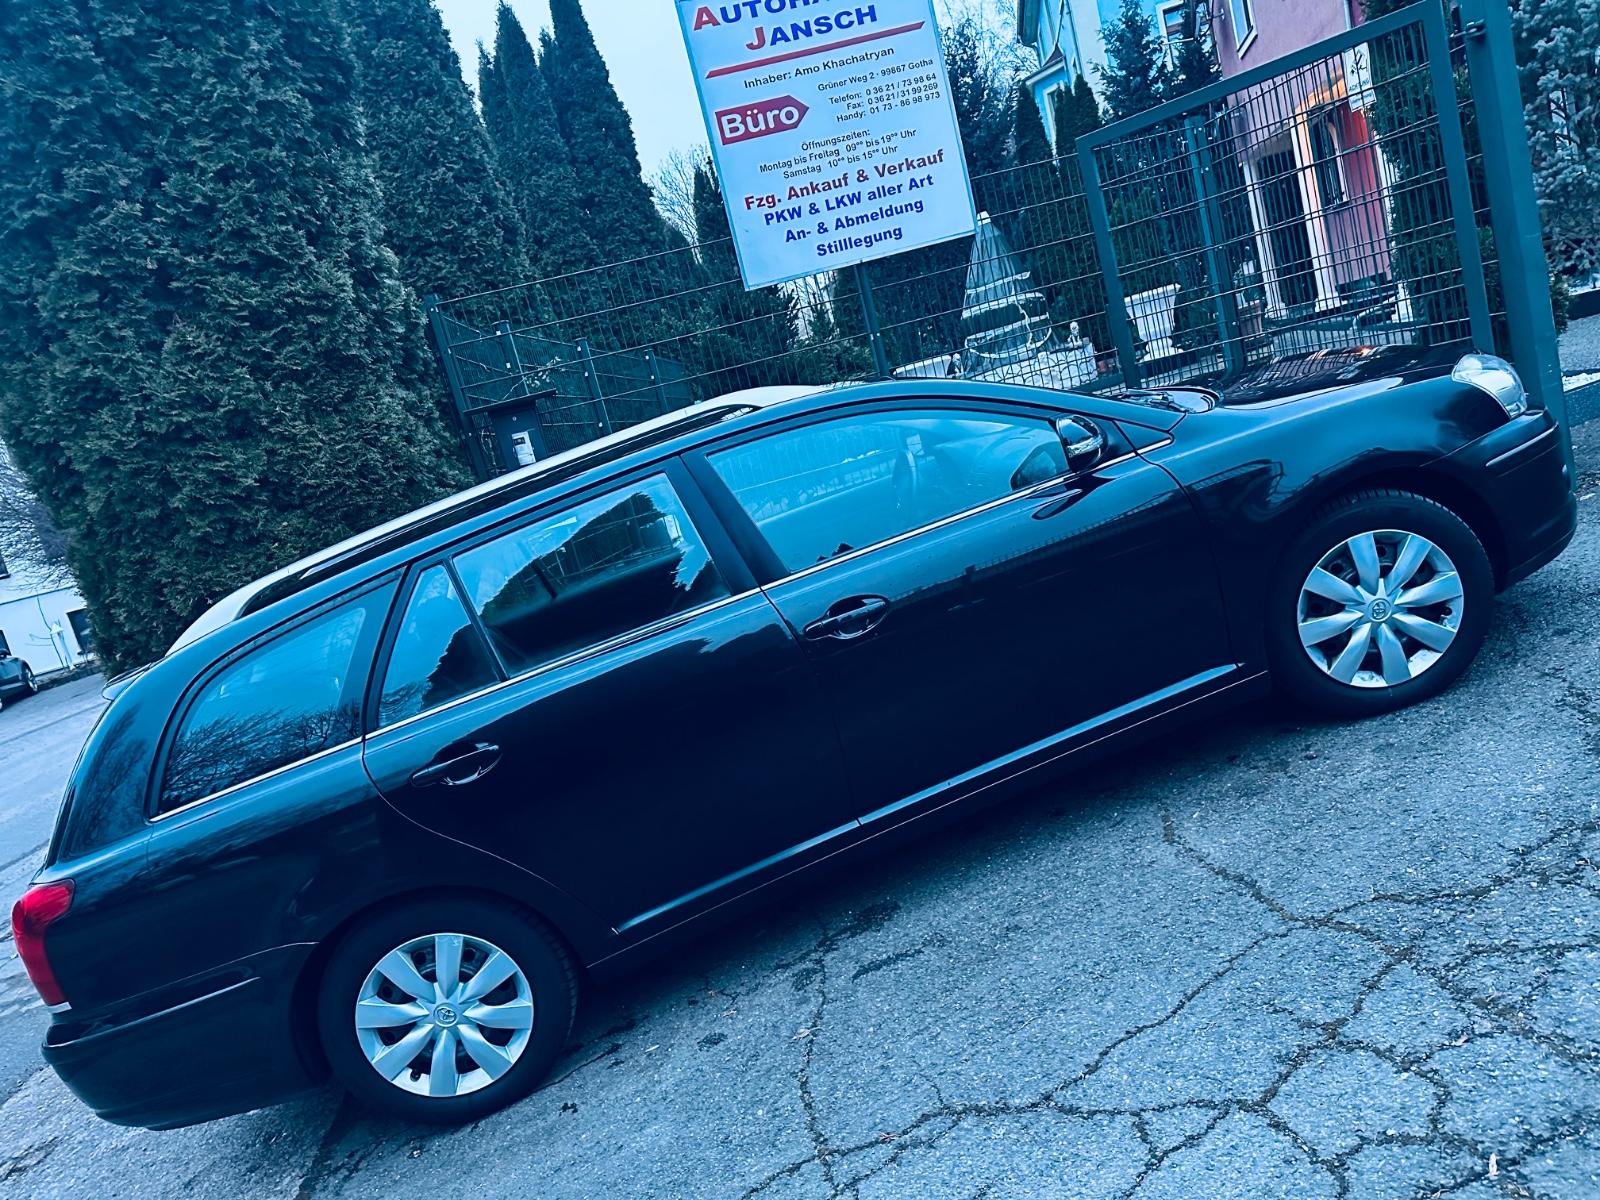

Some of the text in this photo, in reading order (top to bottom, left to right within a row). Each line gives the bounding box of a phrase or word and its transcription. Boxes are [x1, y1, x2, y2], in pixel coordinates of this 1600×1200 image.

[693, 0, 830, 31] AUTO
[745, 4, 878, 51] JANSCH
[744, 47, 895, 89] Inhaber: Amo Khachatryan
[817, 79, 848, 92] Grüner
[848, 74, 868, 84] Weg
[869, 71, 875, 80] 2
[880, 64, 906, 77] 99867
[907, 59, 933, 70] Gotha
[829, 92, 863, 105] Telefon:
[865, 88, 871, 96] 0
[873, 86, 884, 94] 36
[885, 83, 895, 91] 21
[902, 79, 912, 87] 73
[914, 76, 925, 84] 98
[926, 73, 937, 81] 64
[846, 101, 865, 111] Fax:
[867, 97, 873, 105] 0
[874, 94, 885, 103] 36
[886, 92, 896, 100] 21
[900, 88, 911, 96] 31
[911, 86, 922, 94] 99
[923, 82, 939, 92] 269
[720, 106, 800, 139] Büro
[836, 110, 866, 123] Handy:
[869, 106, 880, 115] 01
[882, 103, 893, 111] 73
[900, 98, 911, 107] 86
[912, 95, 923, 104] 98
[924, 91, 940, 101] 973
[759, 158, 793, 173] Montag
[794, 156, 807, 165] bis
[808, 148, 840, 163] Freitag
[865, 137, 880, 148] bis
[900, 129, 917, 139] Uhr
[801, 129, 870, 151] Öffnungszeiten:
[783, 164, 822, 179] Samstag
[847, 154, 861, 164] bis
[881, 145, 898, 156] Uhr
[744, 149, 944, 210] Fzg. Ankauf & Verkauf
[764, 174, 934, 226] PKW & LKW aller Art
[785, 200, 924, 243] An- & Abmeldung
[816, 227, 903, 257] Stilllegung
